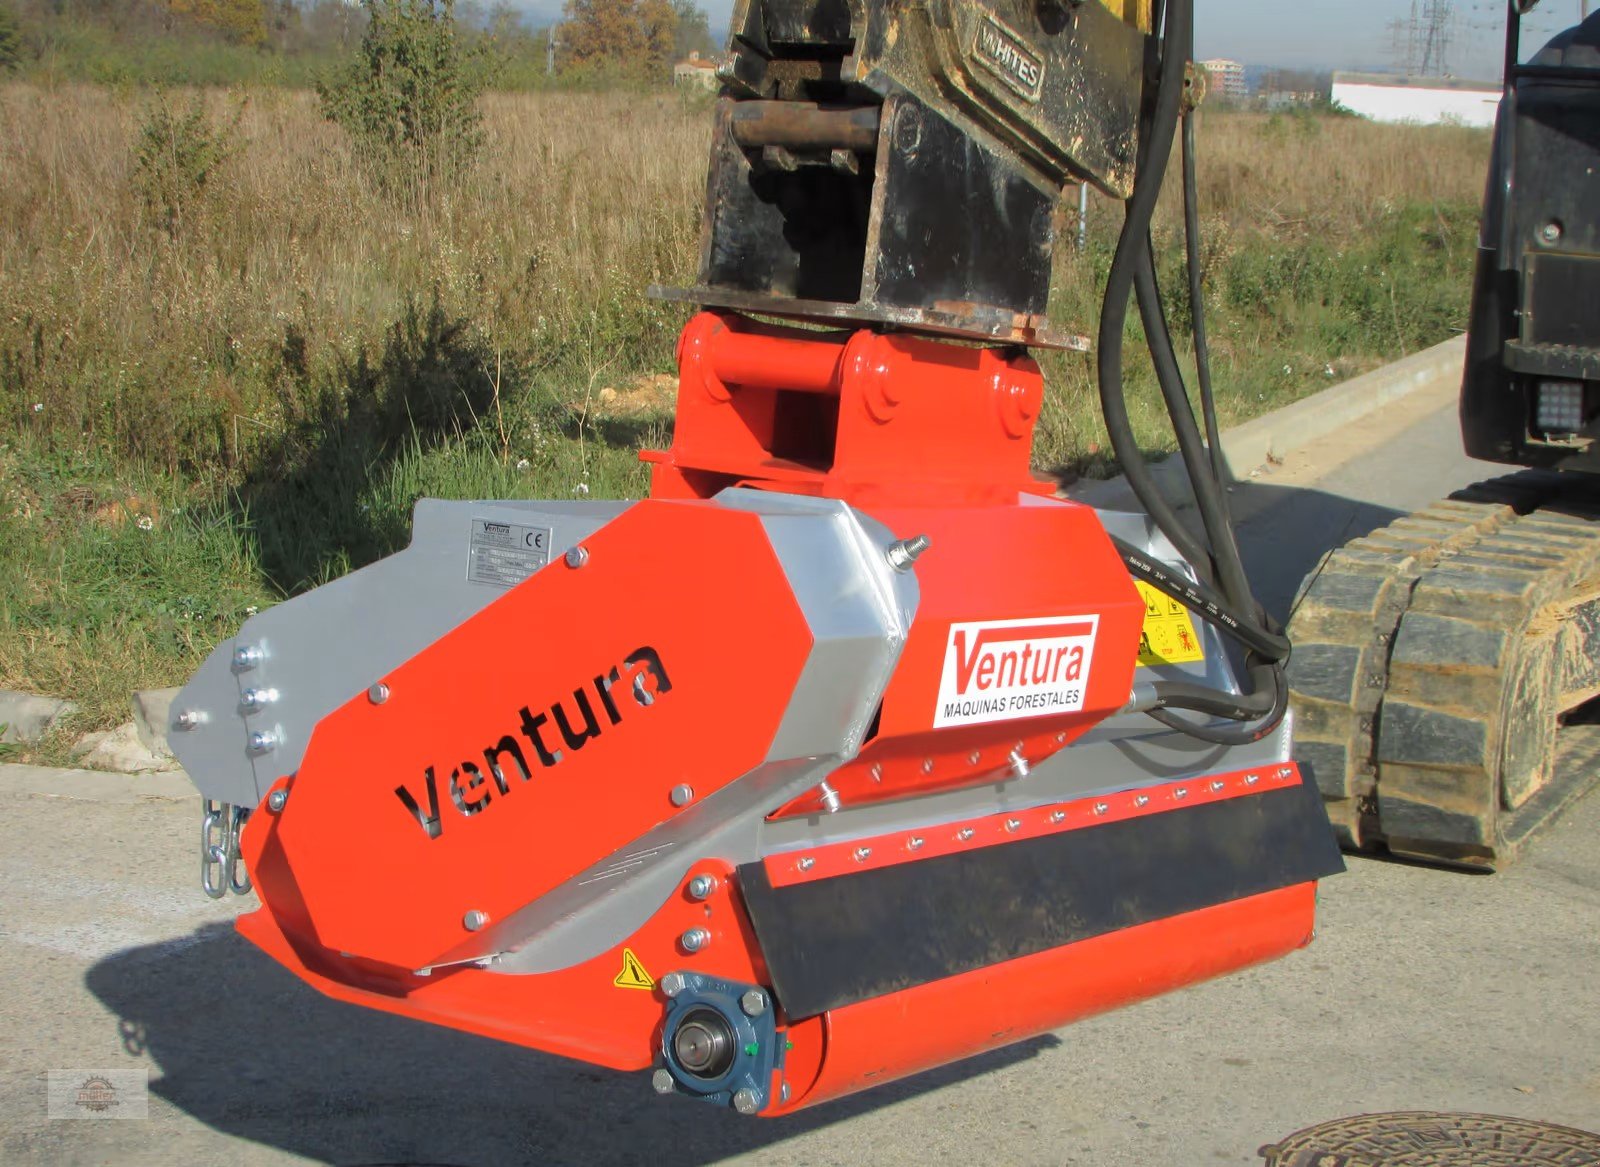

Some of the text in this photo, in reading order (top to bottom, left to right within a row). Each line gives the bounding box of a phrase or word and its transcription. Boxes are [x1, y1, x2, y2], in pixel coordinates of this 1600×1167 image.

[483, 522, 510, 534] Ventura
[525, 532, 542, 548] CE
[953, 621, 1094, 696] Ventura
[1009, 689, 1080, 711] FORESTALES
[394, 645, 673, 840] Ventura
